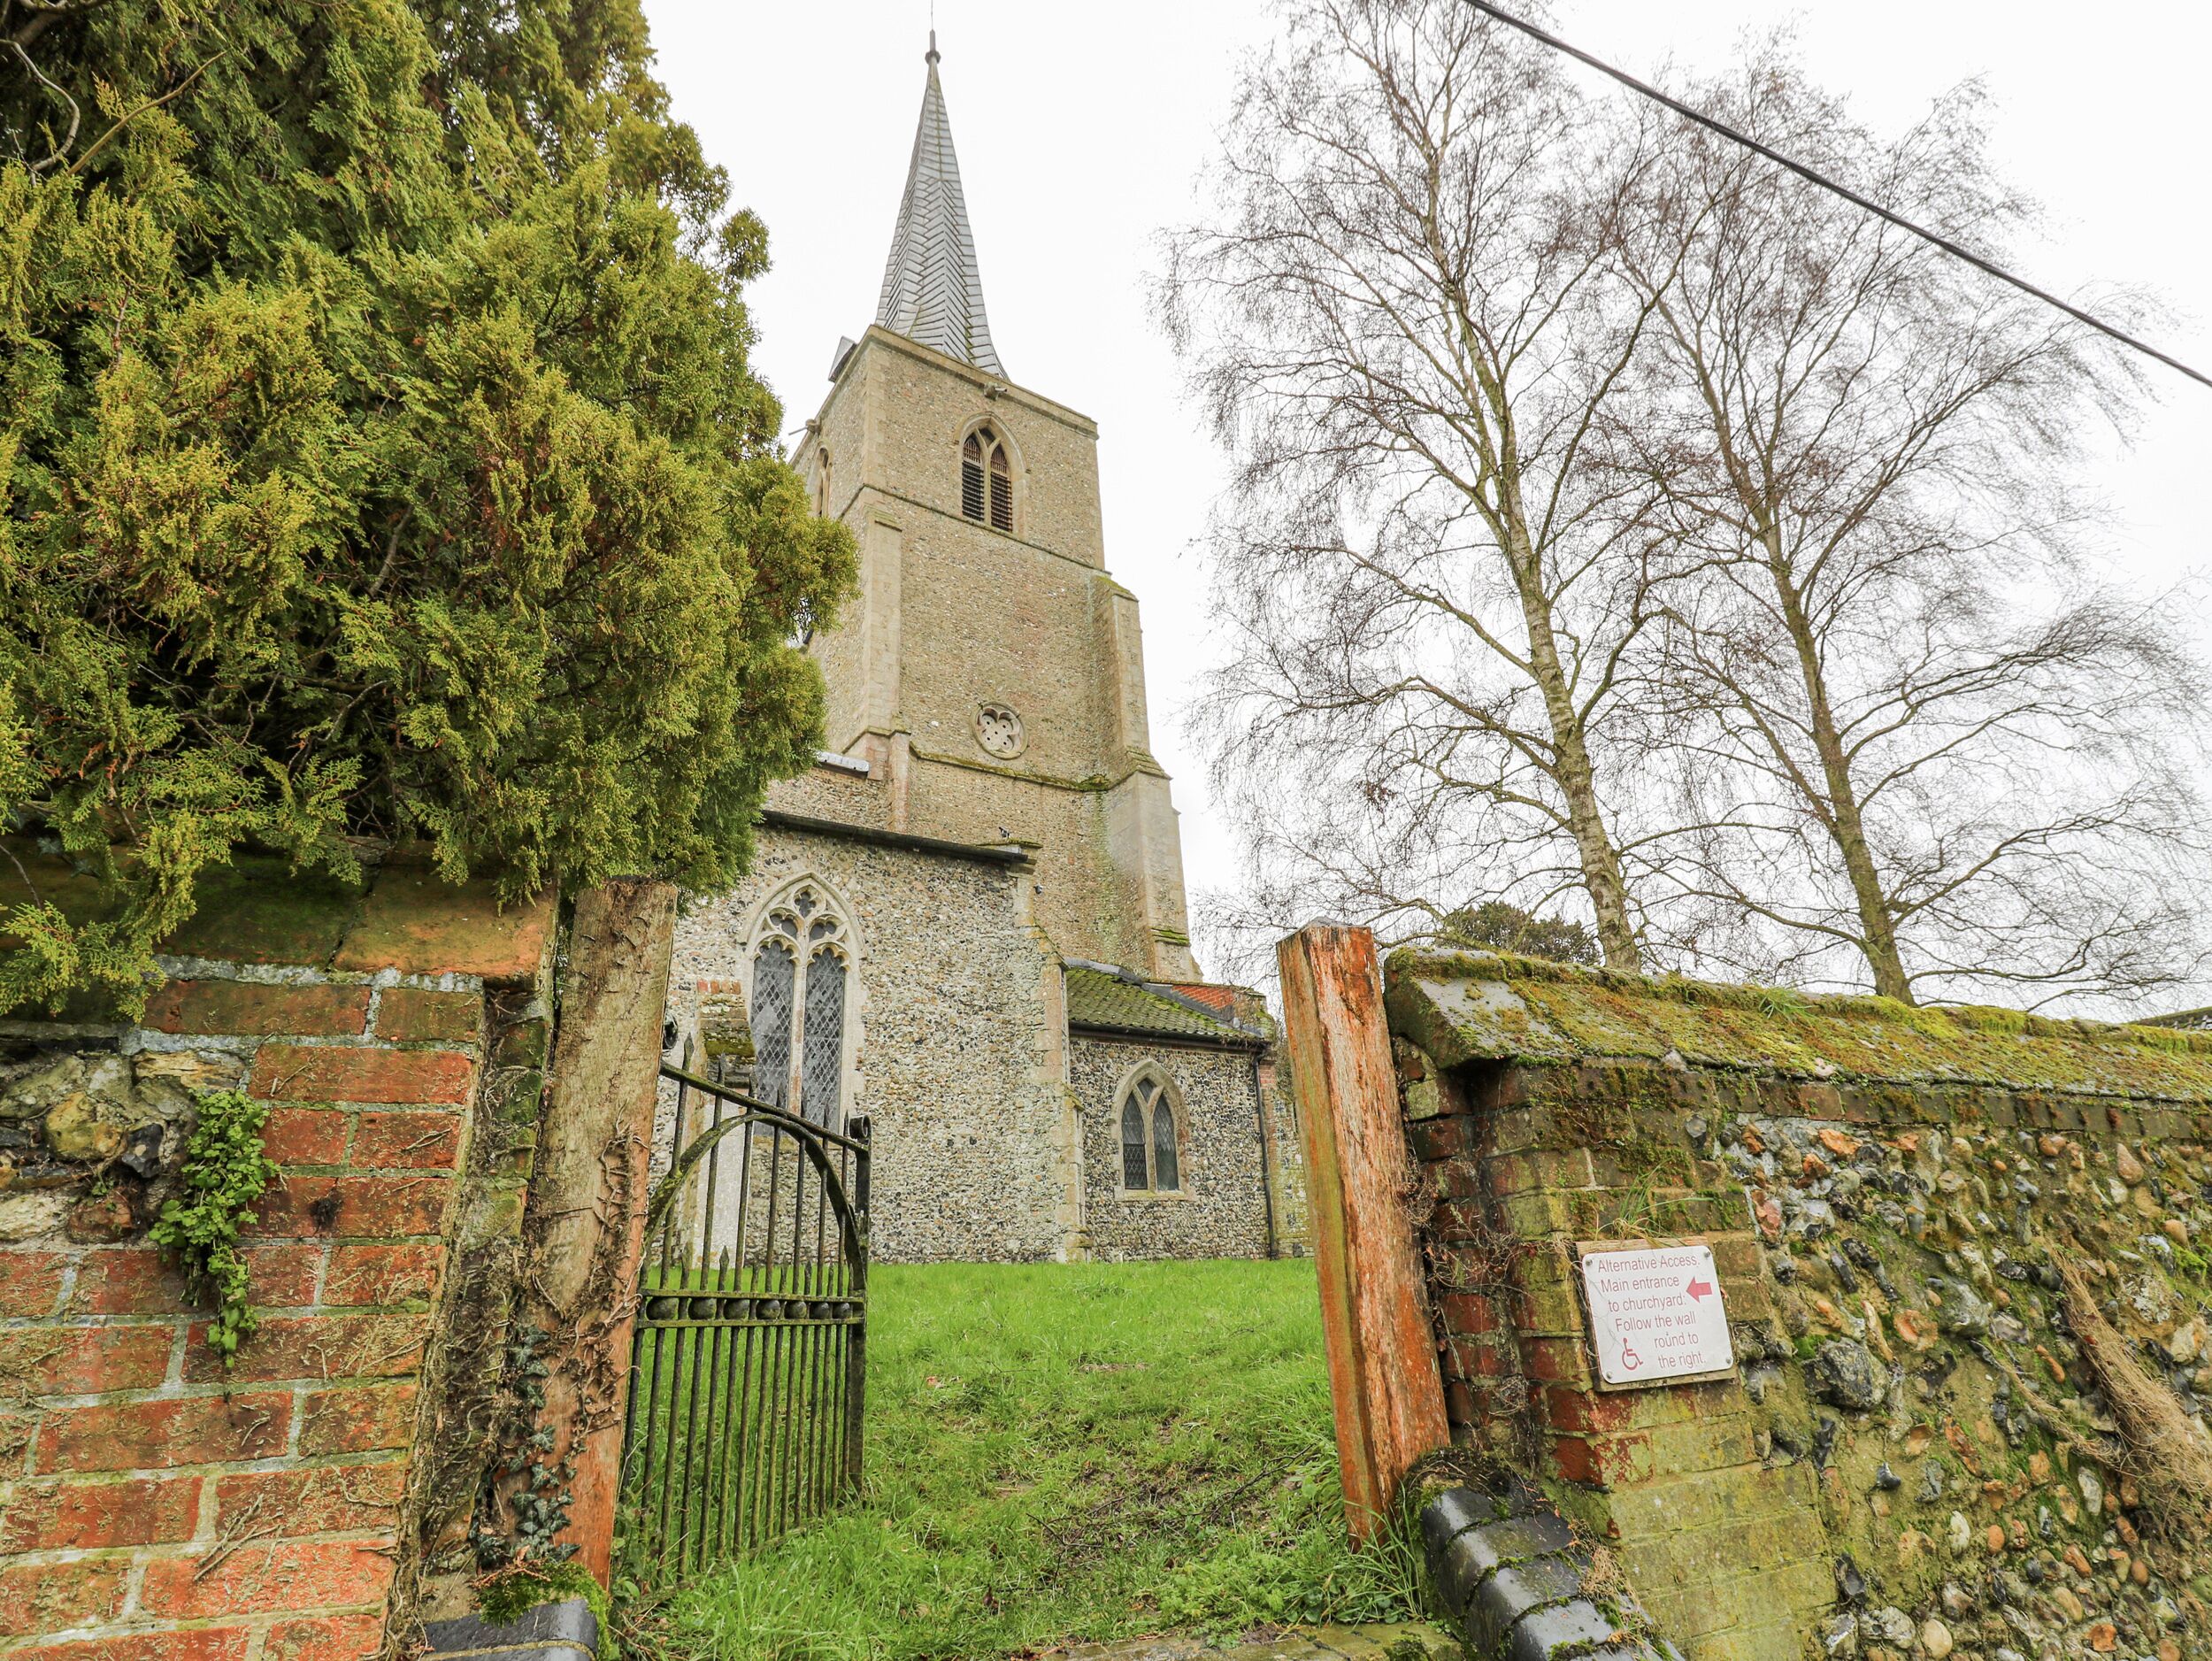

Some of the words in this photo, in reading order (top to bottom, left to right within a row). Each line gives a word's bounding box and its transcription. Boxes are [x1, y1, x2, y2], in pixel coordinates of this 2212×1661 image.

[1598, 1257, 1657, 1273] Alternative
[1601, 1280, 1629, 1292] Main
[1632, 1276, 1679, 1289] entrance
[1609, 1300, 1619, 1312] to
[1616, 1318, 1651, 1332] Follow
[1655, 1315, 1671, 1327] the
[1675, 1311, 1695, 1325] wall
[1654, 1333, 1685, 1348] round
[1688, 1333, 1698, 1344] to
[1658, 1354, 1676, 1368] the
[1679, 1353, 1705, 1368] right.
